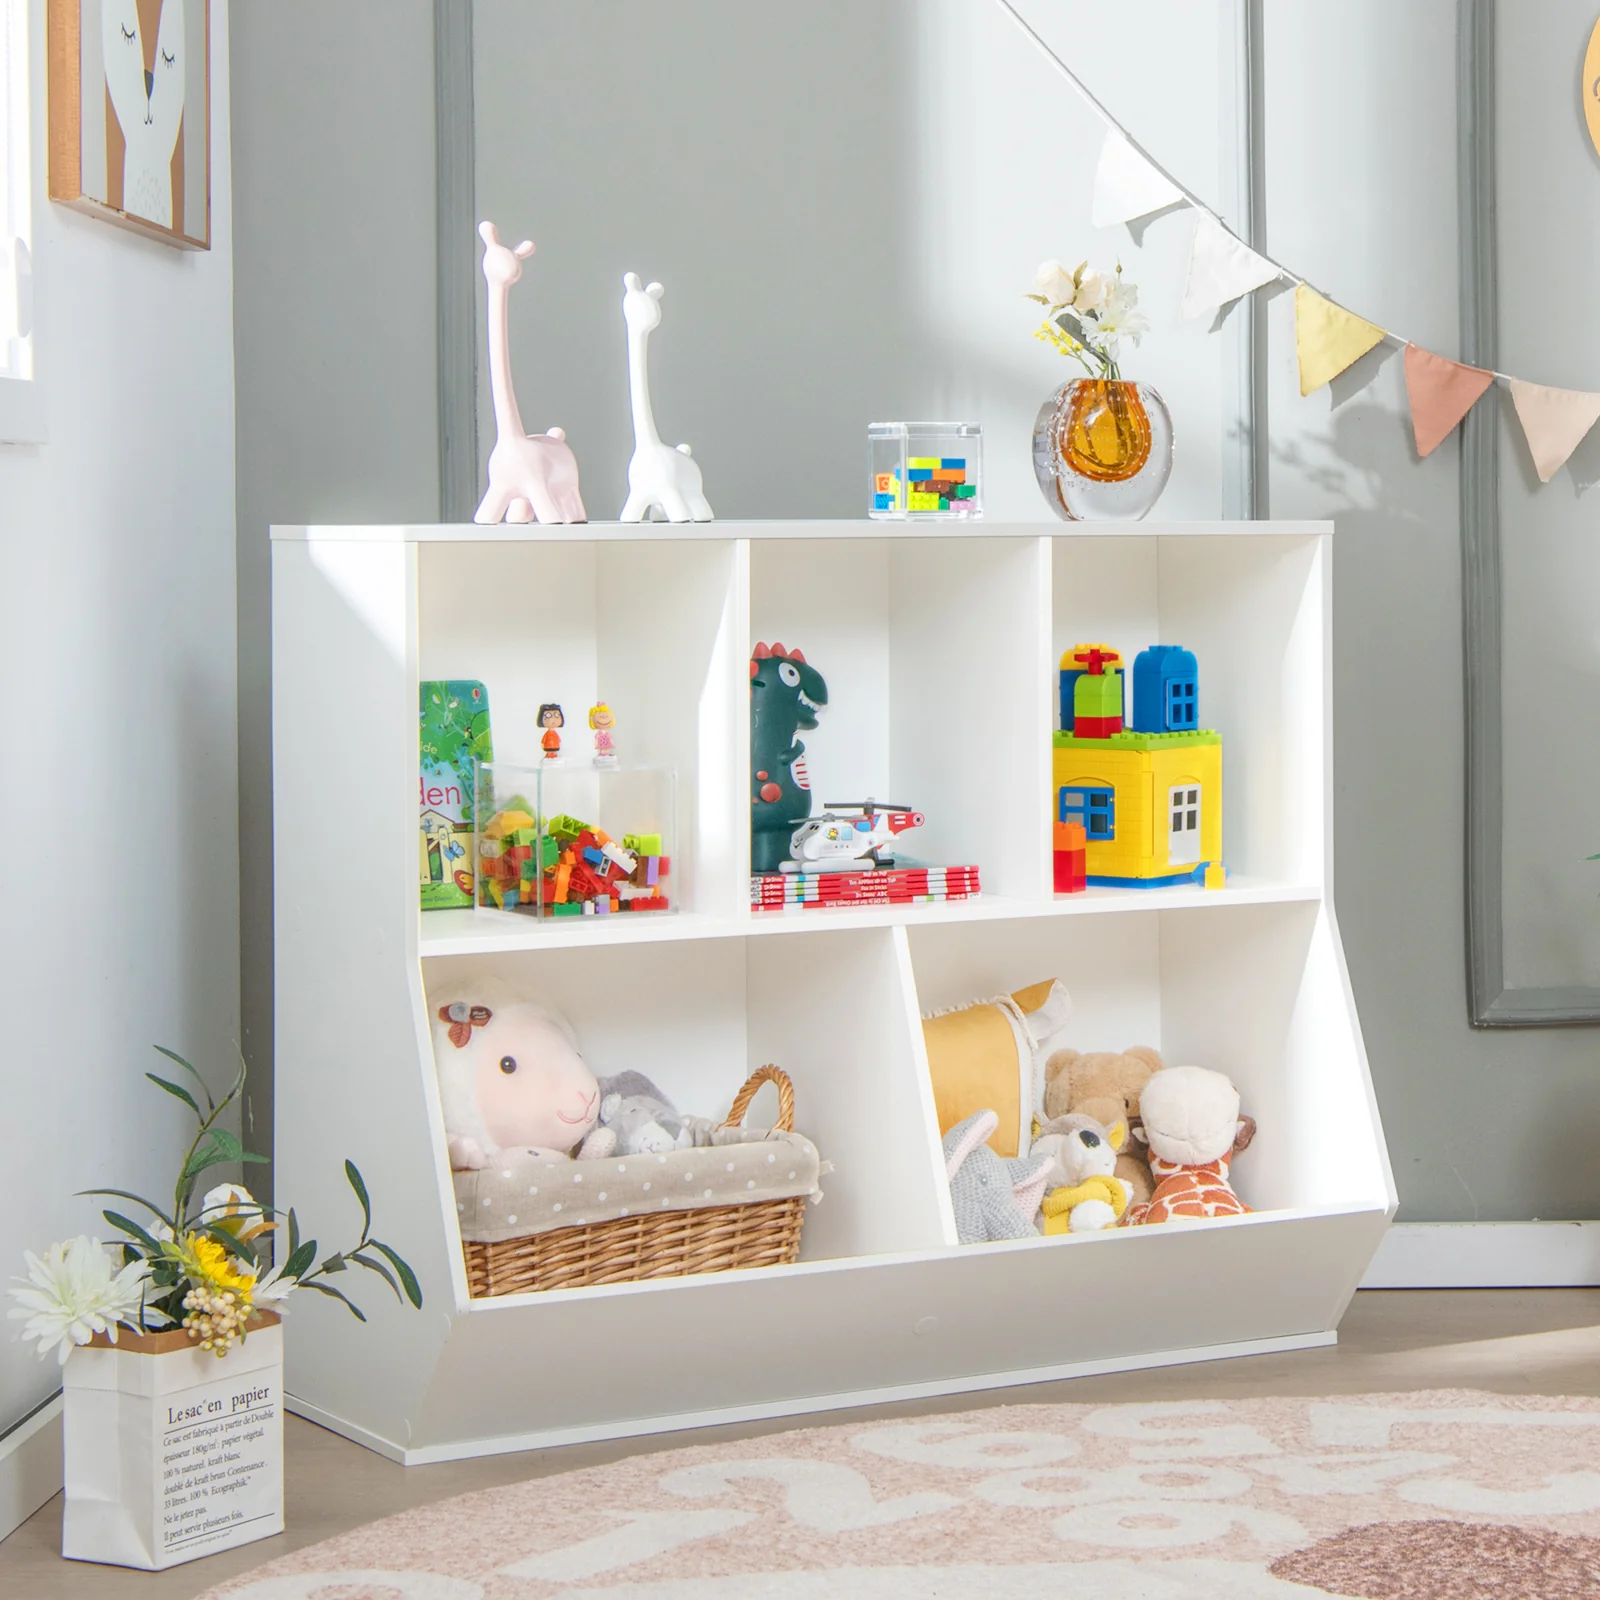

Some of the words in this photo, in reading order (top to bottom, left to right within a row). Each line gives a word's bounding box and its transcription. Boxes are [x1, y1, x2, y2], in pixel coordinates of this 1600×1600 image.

[231, 1386, 270, 1412] papier
[251, 1409, 274, 1423] Double
[972, 1463, 1253, 1509] 8
